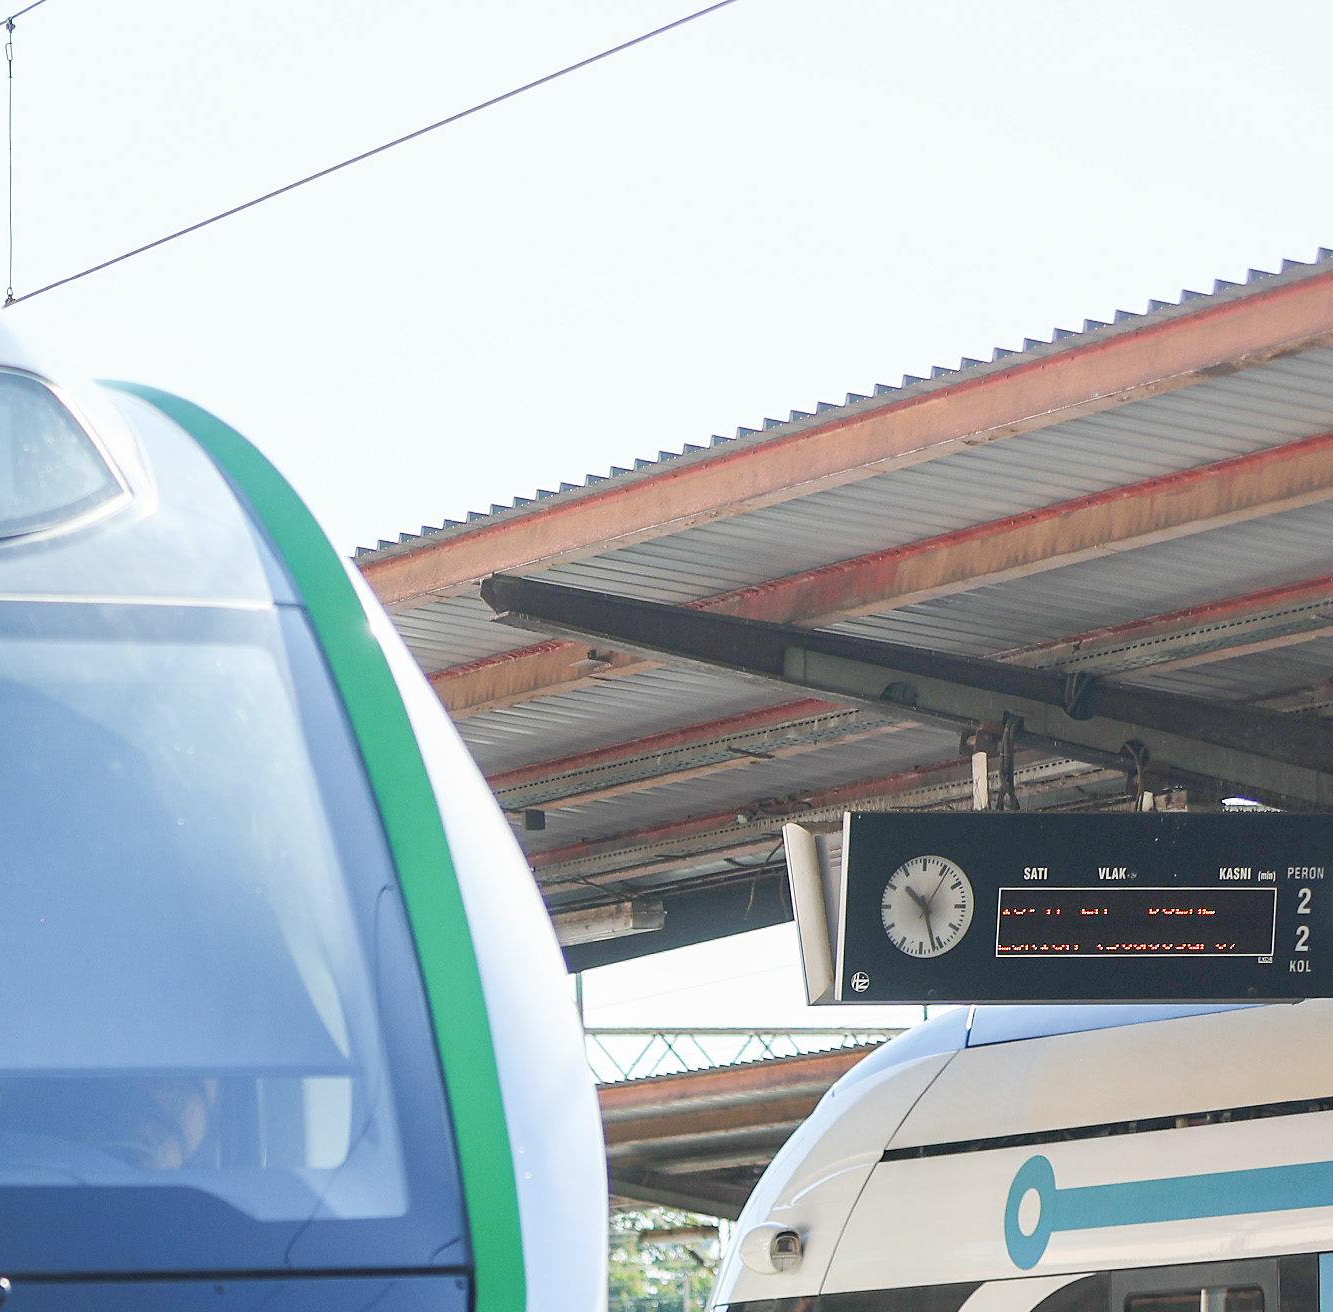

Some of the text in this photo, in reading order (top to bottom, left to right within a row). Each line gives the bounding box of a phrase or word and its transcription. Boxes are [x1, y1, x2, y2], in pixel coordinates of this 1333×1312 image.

[1023, 866, 1048, 880] SATI
[1098, 866, 1127, 880] VLAK
[1218, 867, 1252, 880] KASNI
[1287, 866, 1325, 880] PERON
[1296, 887, 1312, 914] 2
[1294, 925, 1310, 952] 2
[1289, 960, 1312, 973] KOL
